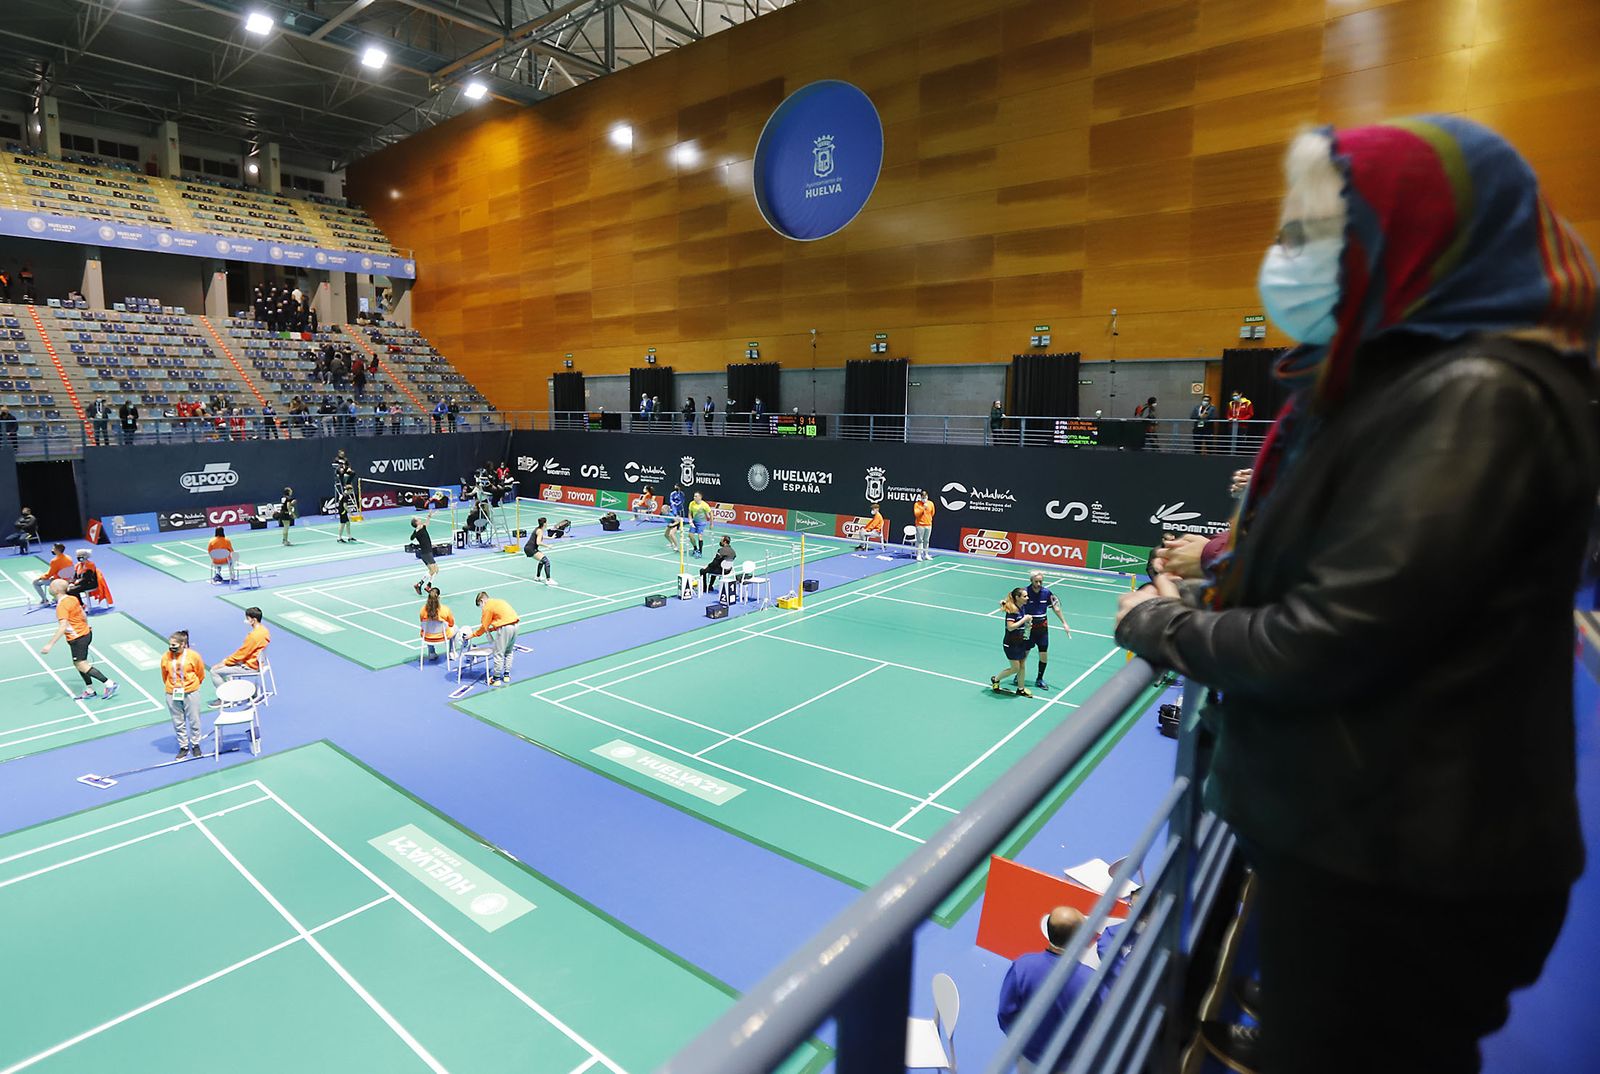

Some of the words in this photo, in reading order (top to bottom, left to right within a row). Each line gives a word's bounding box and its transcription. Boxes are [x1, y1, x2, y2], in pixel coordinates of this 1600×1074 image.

[806, 184, 842, 198] HUELVA
[800, 416, 804, 425] 9
[798, 426, 805, 434] 21
[391, 458, 425, 472] YONEX
[696, 477, 721, 486] HUELVA
[783, 483, 821, 494] ESPAÑA
[970, 487, 1016, 502] Andalucía
[567, 491, 594, 502] TOYOTA
[744, 511, 784, 525] TOYOTA
[1163, 522, 1230, 534] BADMINTO
[1019, 541, 1083, 560] TOYOTA
